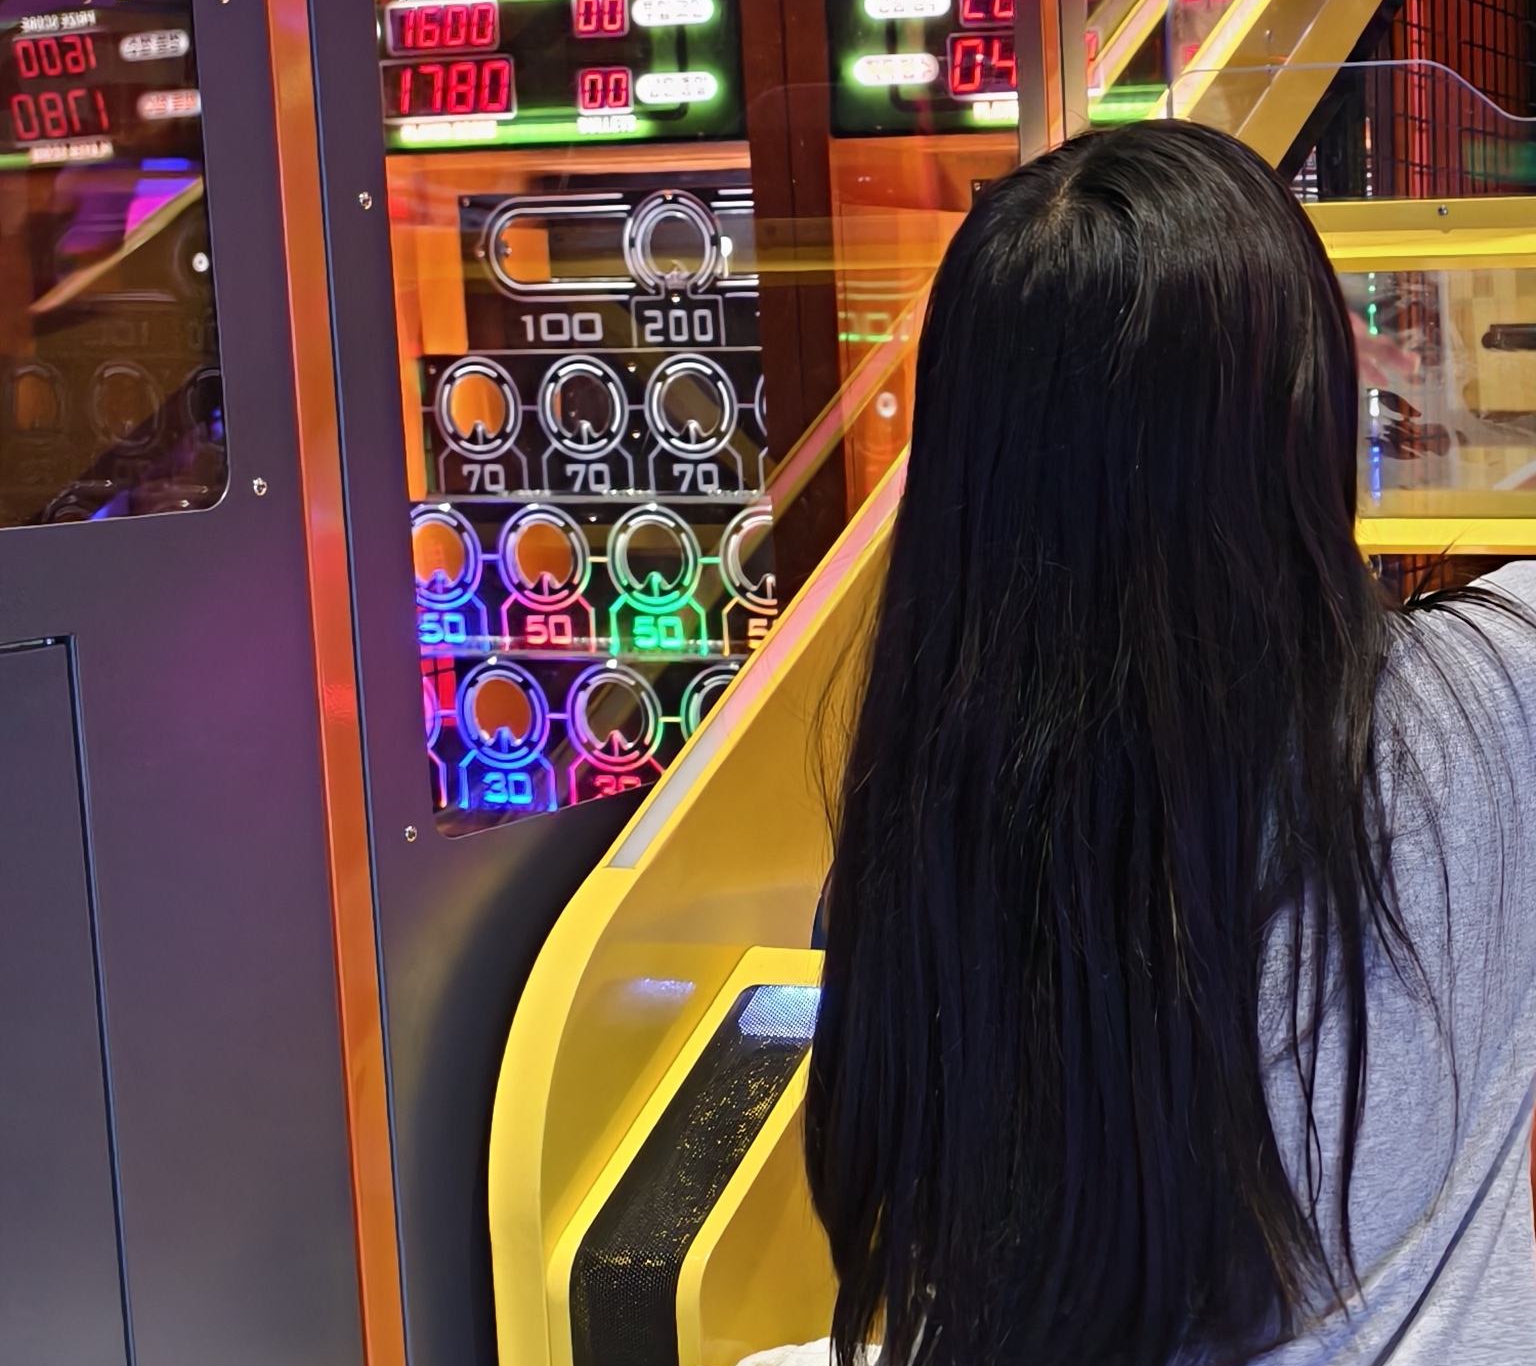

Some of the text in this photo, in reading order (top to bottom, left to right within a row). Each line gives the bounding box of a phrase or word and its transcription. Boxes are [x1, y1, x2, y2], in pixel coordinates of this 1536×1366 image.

[404, 3, 496, 49] 1600
[400, 59, 511, 115] 1780
[521, 312, 603, 342] 100
[643, 309, 714, 343] 200
[462, 463, 506, 493] 70
[566, 463, 611, 493] 70
[673, 463, 719, 493] 70
[418, 612, 467, 645] 50
[525, 615, 572, 646] 50
[633, 615, 684, 649] 50
[482, 772, 534, 805] 30
